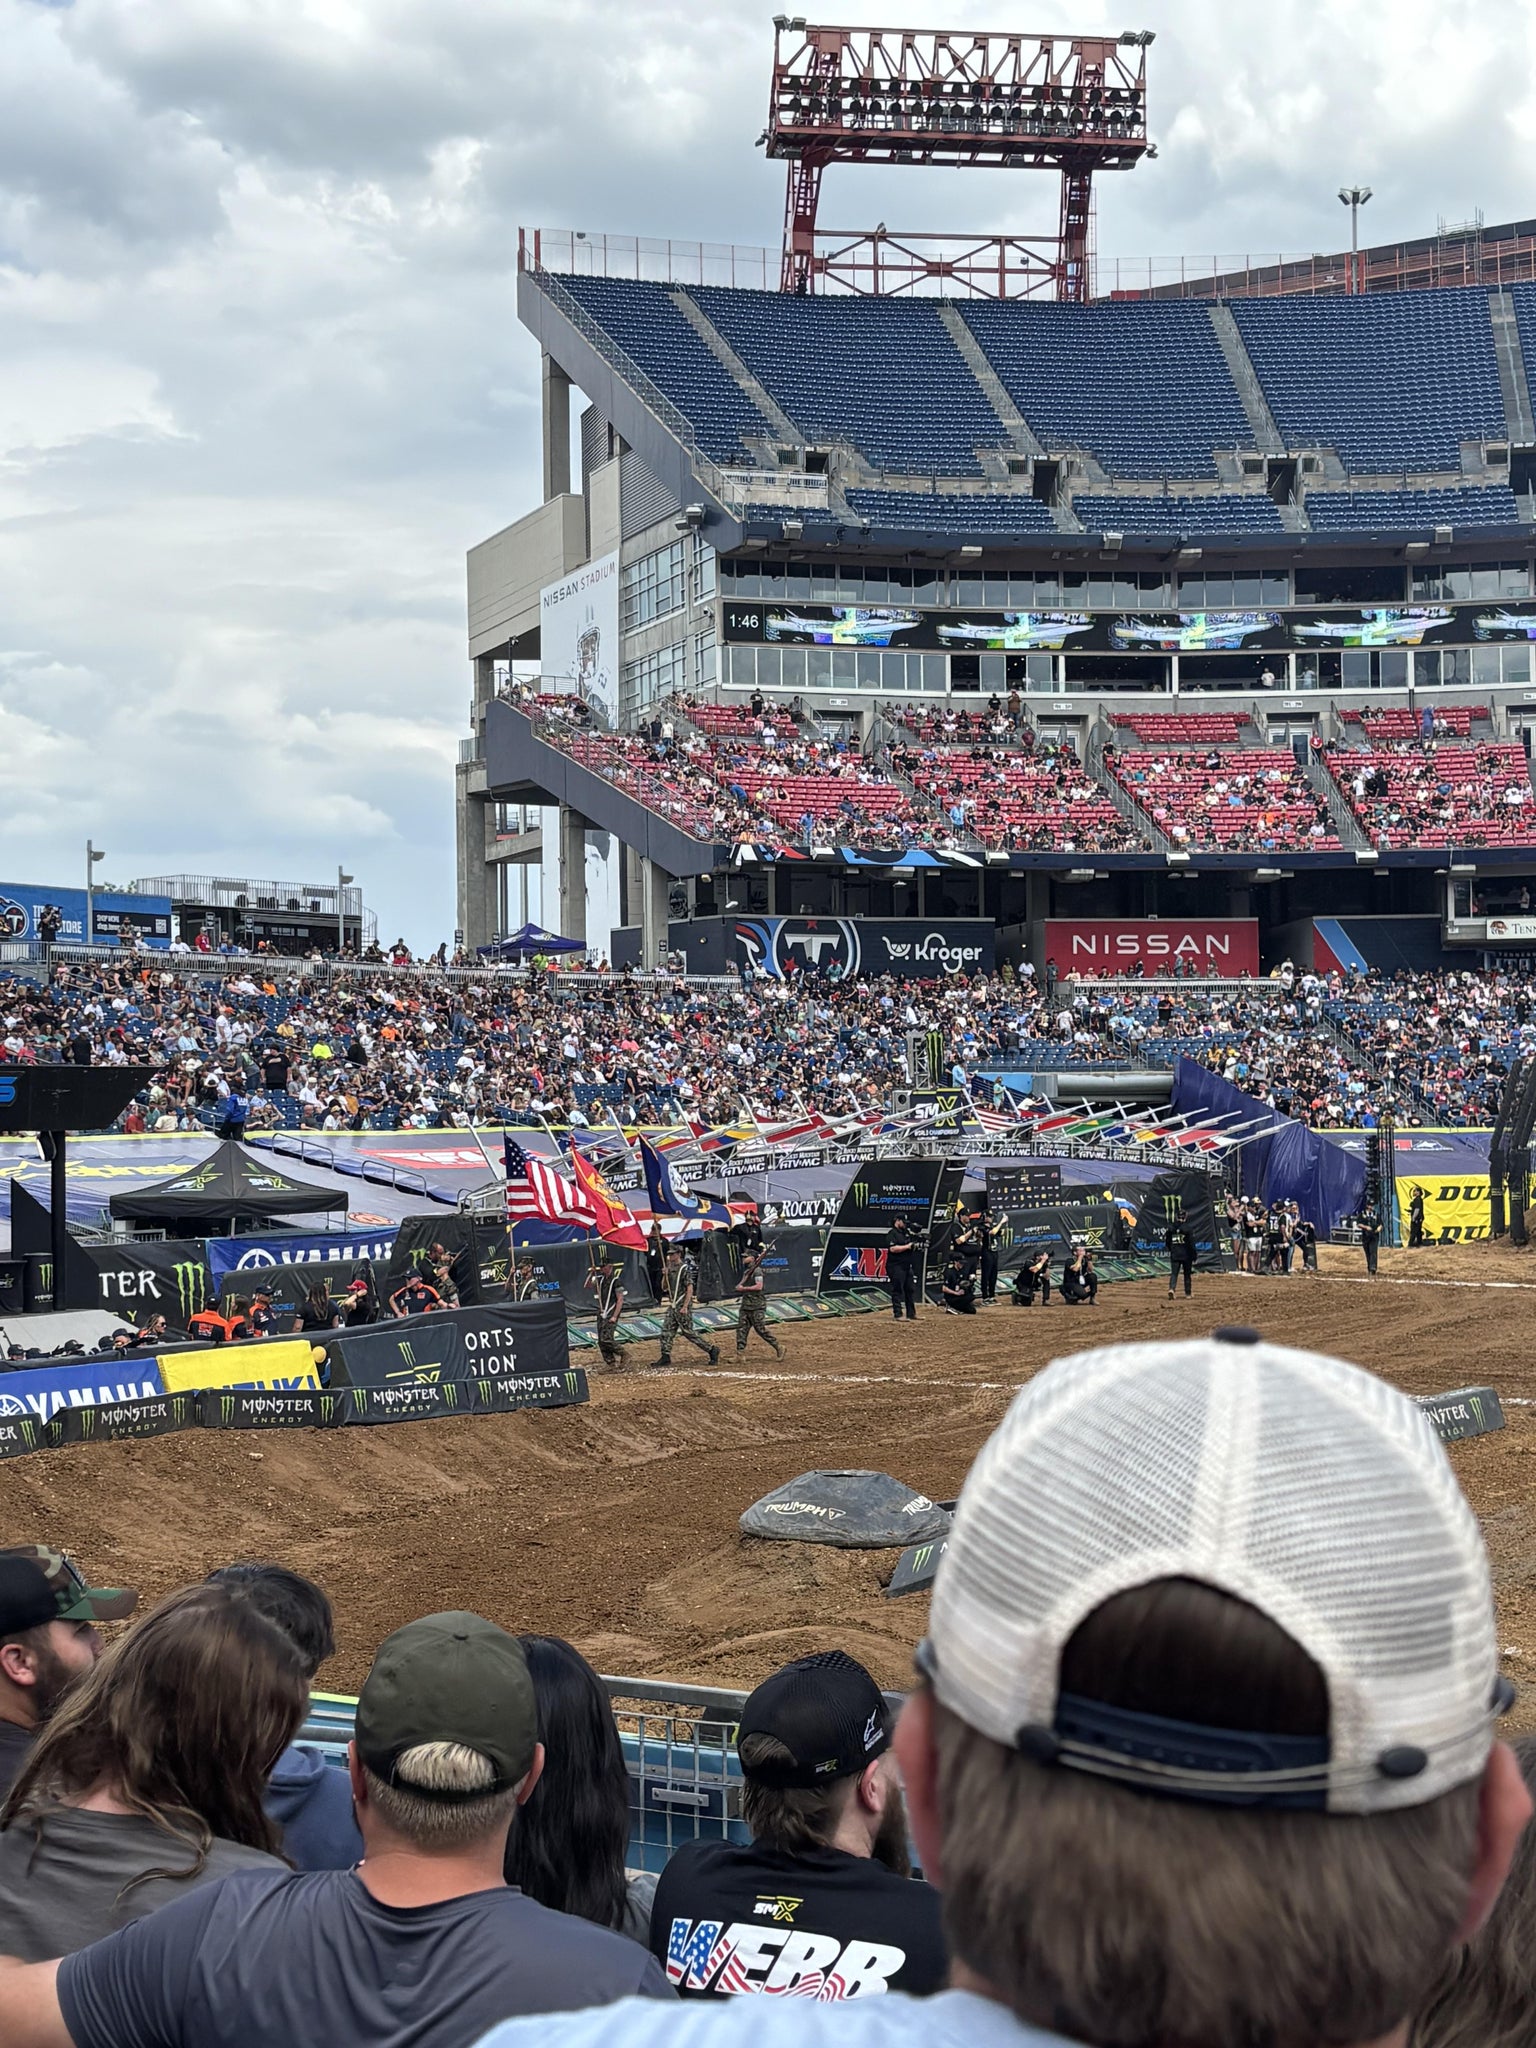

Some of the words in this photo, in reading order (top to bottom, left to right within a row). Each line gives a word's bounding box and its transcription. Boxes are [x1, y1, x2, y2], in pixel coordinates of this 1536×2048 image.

[543, 581, 579, 608] NISSAN
[580, 561, 616, 591] STADIUM
[729, 613, 759, 629] 1:46
[915, 932, 983, 973] Kroger
[1072, 934, 1230, 955] NISSAN
[914, 1095, 958, 1127] SMX
[780, 1200, 820, 1218] ROCKY
[1070, 1230, 1104, 1246] SMX
[481, 1263, 507, 1281] SMX
[498, 1376, 561, 1394] MONSTER
[373, 1387, 440, 1405] MONSTER
[509, 1392, 553, 1402] ENERGY
[101, 1403, 167, 1426] MONSTER
[242, 1397, 314, 1415] MONSTER
[385, 1404, 431, 1414] ENERGY
[252, 1416, 303, 1424] ENERGY
[764, 1501, 827, 1517] TRIUMPH
[753, 1901, 799, 1922] SMX
[666, 1917, 906, 2003] WEBB
